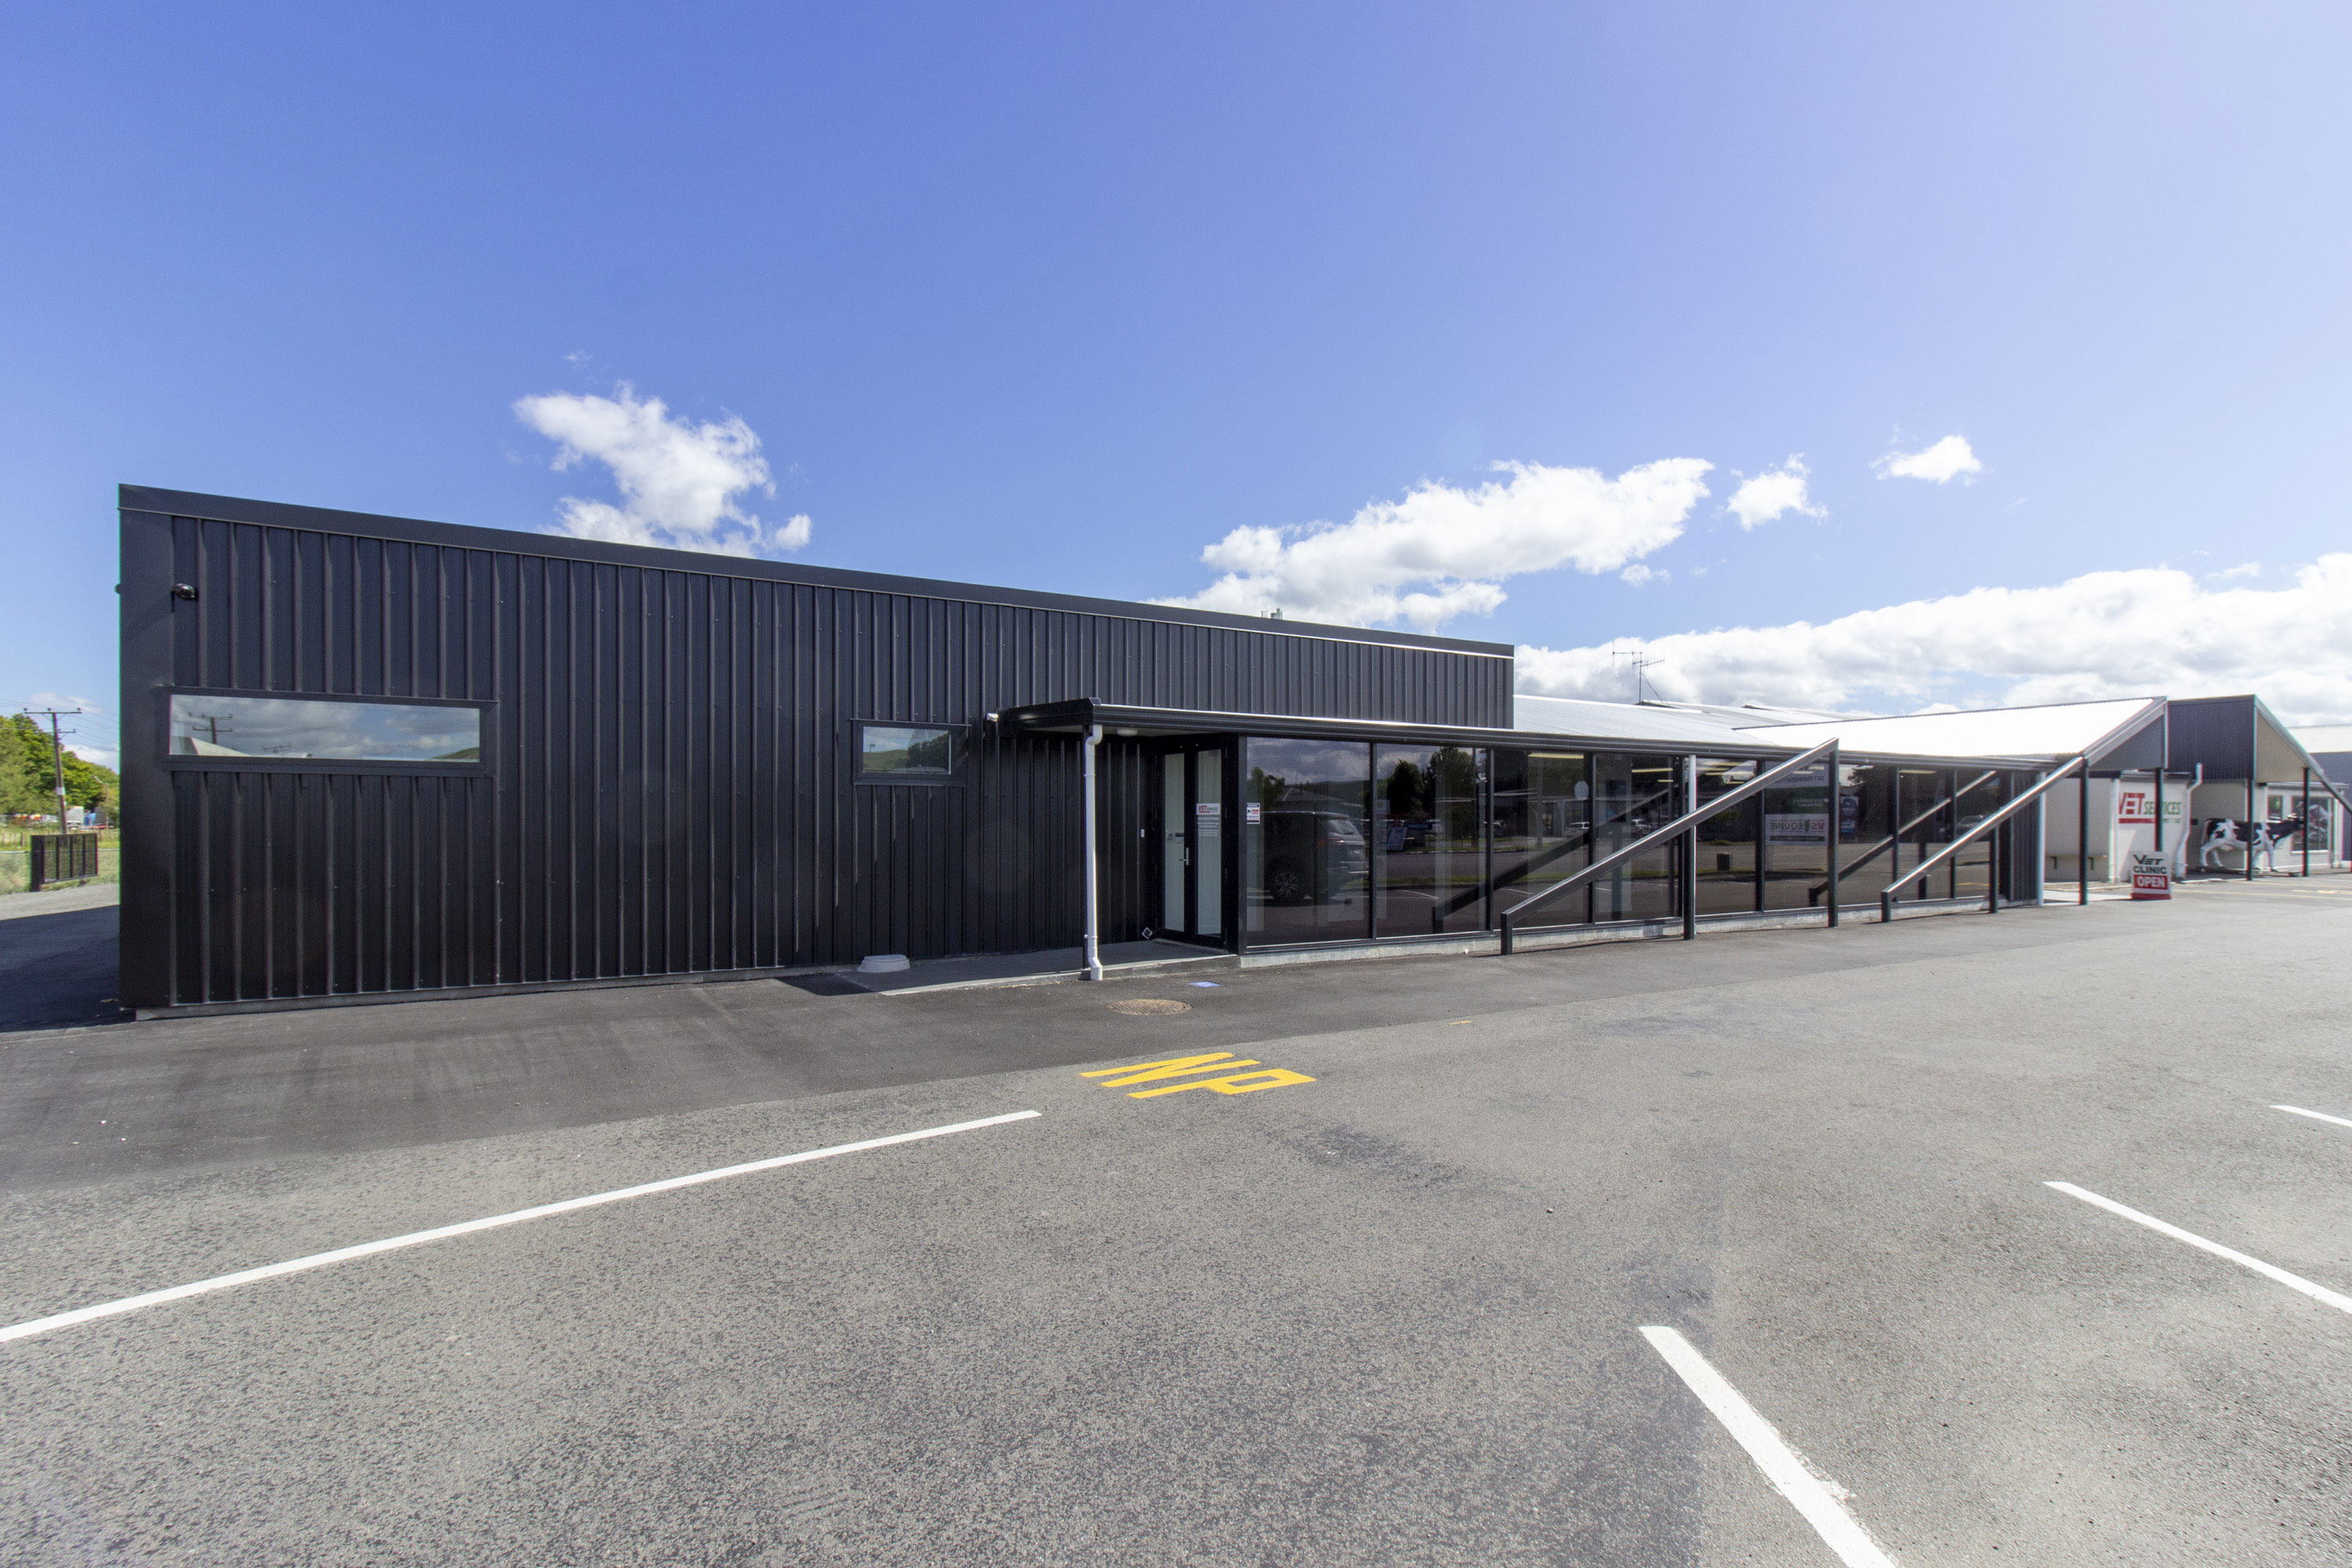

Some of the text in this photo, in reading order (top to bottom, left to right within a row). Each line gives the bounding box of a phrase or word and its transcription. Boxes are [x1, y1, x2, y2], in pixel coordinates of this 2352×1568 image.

[2118, 793, 2182, 815] VET SEICES
[2133, 855, 2164, 865] VET
[2133, 866, 2167, 874] CLINIC
[2136, 876, 2165, 887] OPEN
